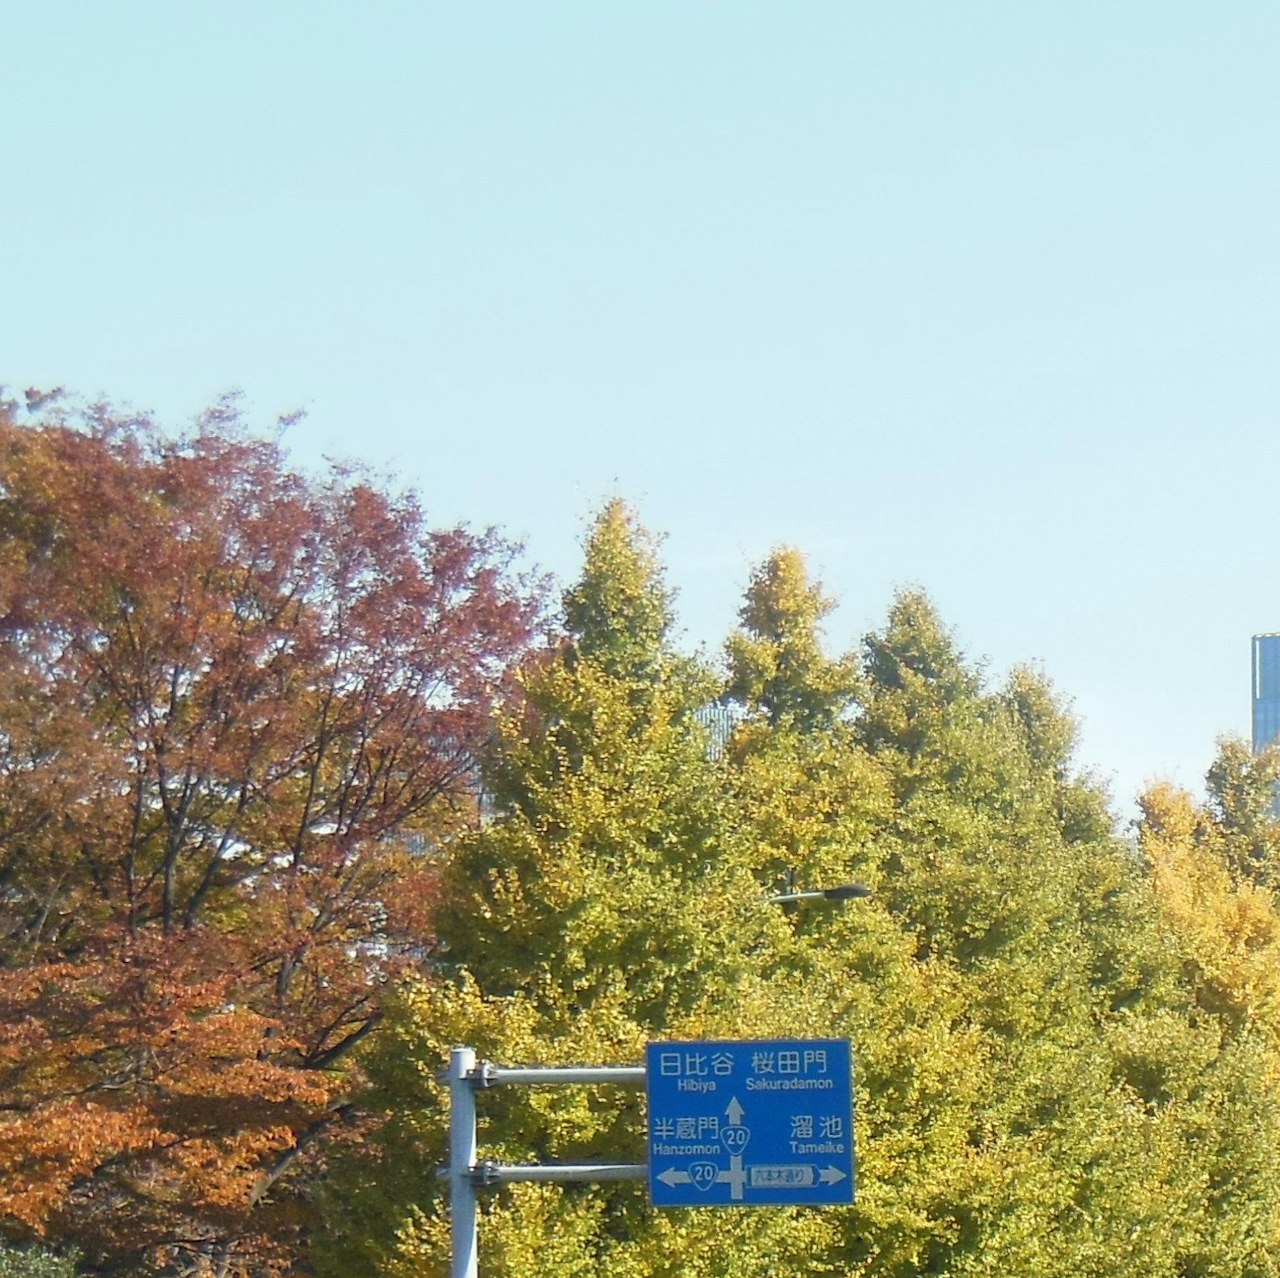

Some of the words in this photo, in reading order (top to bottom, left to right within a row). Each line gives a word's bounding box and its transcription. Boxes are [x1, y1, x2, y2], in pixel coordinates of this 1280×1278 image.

[660, 1052, 735, 1076] 日比谷
[751, 1050, 827, 1075] 桜田門
[677, 1079, 717, 1094] Hibiya
[745, 1077, 833, 1091] Sakuradamon
[653, 1116, 719, 1140] 半蔵門
[790, 1115, 843, 1139] 溜池
[726, 1130, 745, 1145] 20
[653, 1143, 720, 1156] Hanzomon
[789, 1141, 845, 1154] Tameike
[695, 1166, 713, 1181] 20
